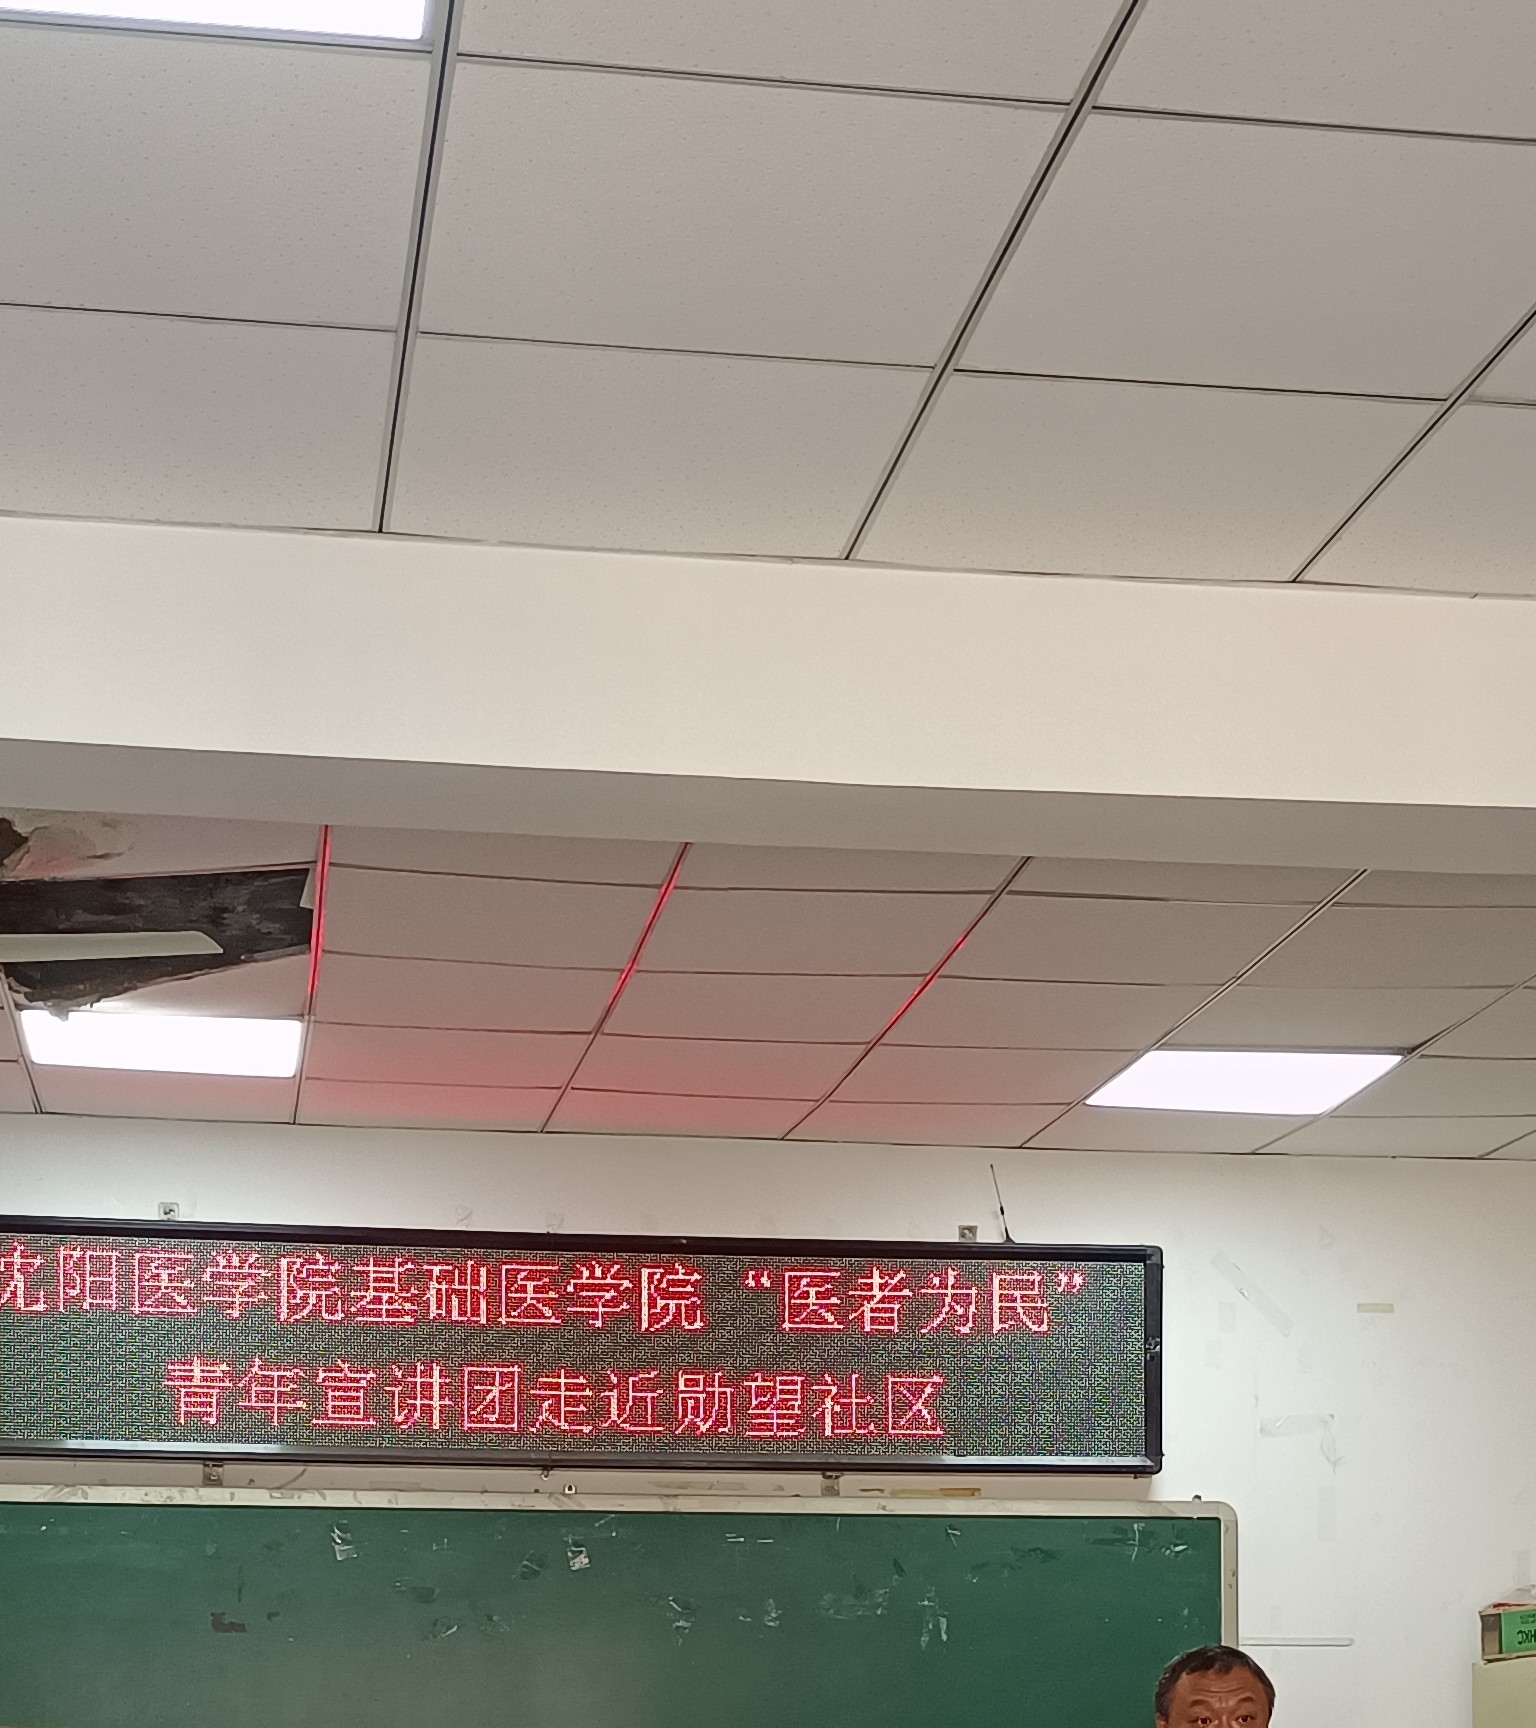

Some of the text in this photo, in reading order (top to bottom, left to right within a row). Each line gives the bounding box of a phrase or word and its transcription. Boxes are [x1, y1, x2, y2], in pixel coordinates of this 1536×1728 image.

[163, 1354, 946, 1440] 青年宣讲团走近勋望社区
